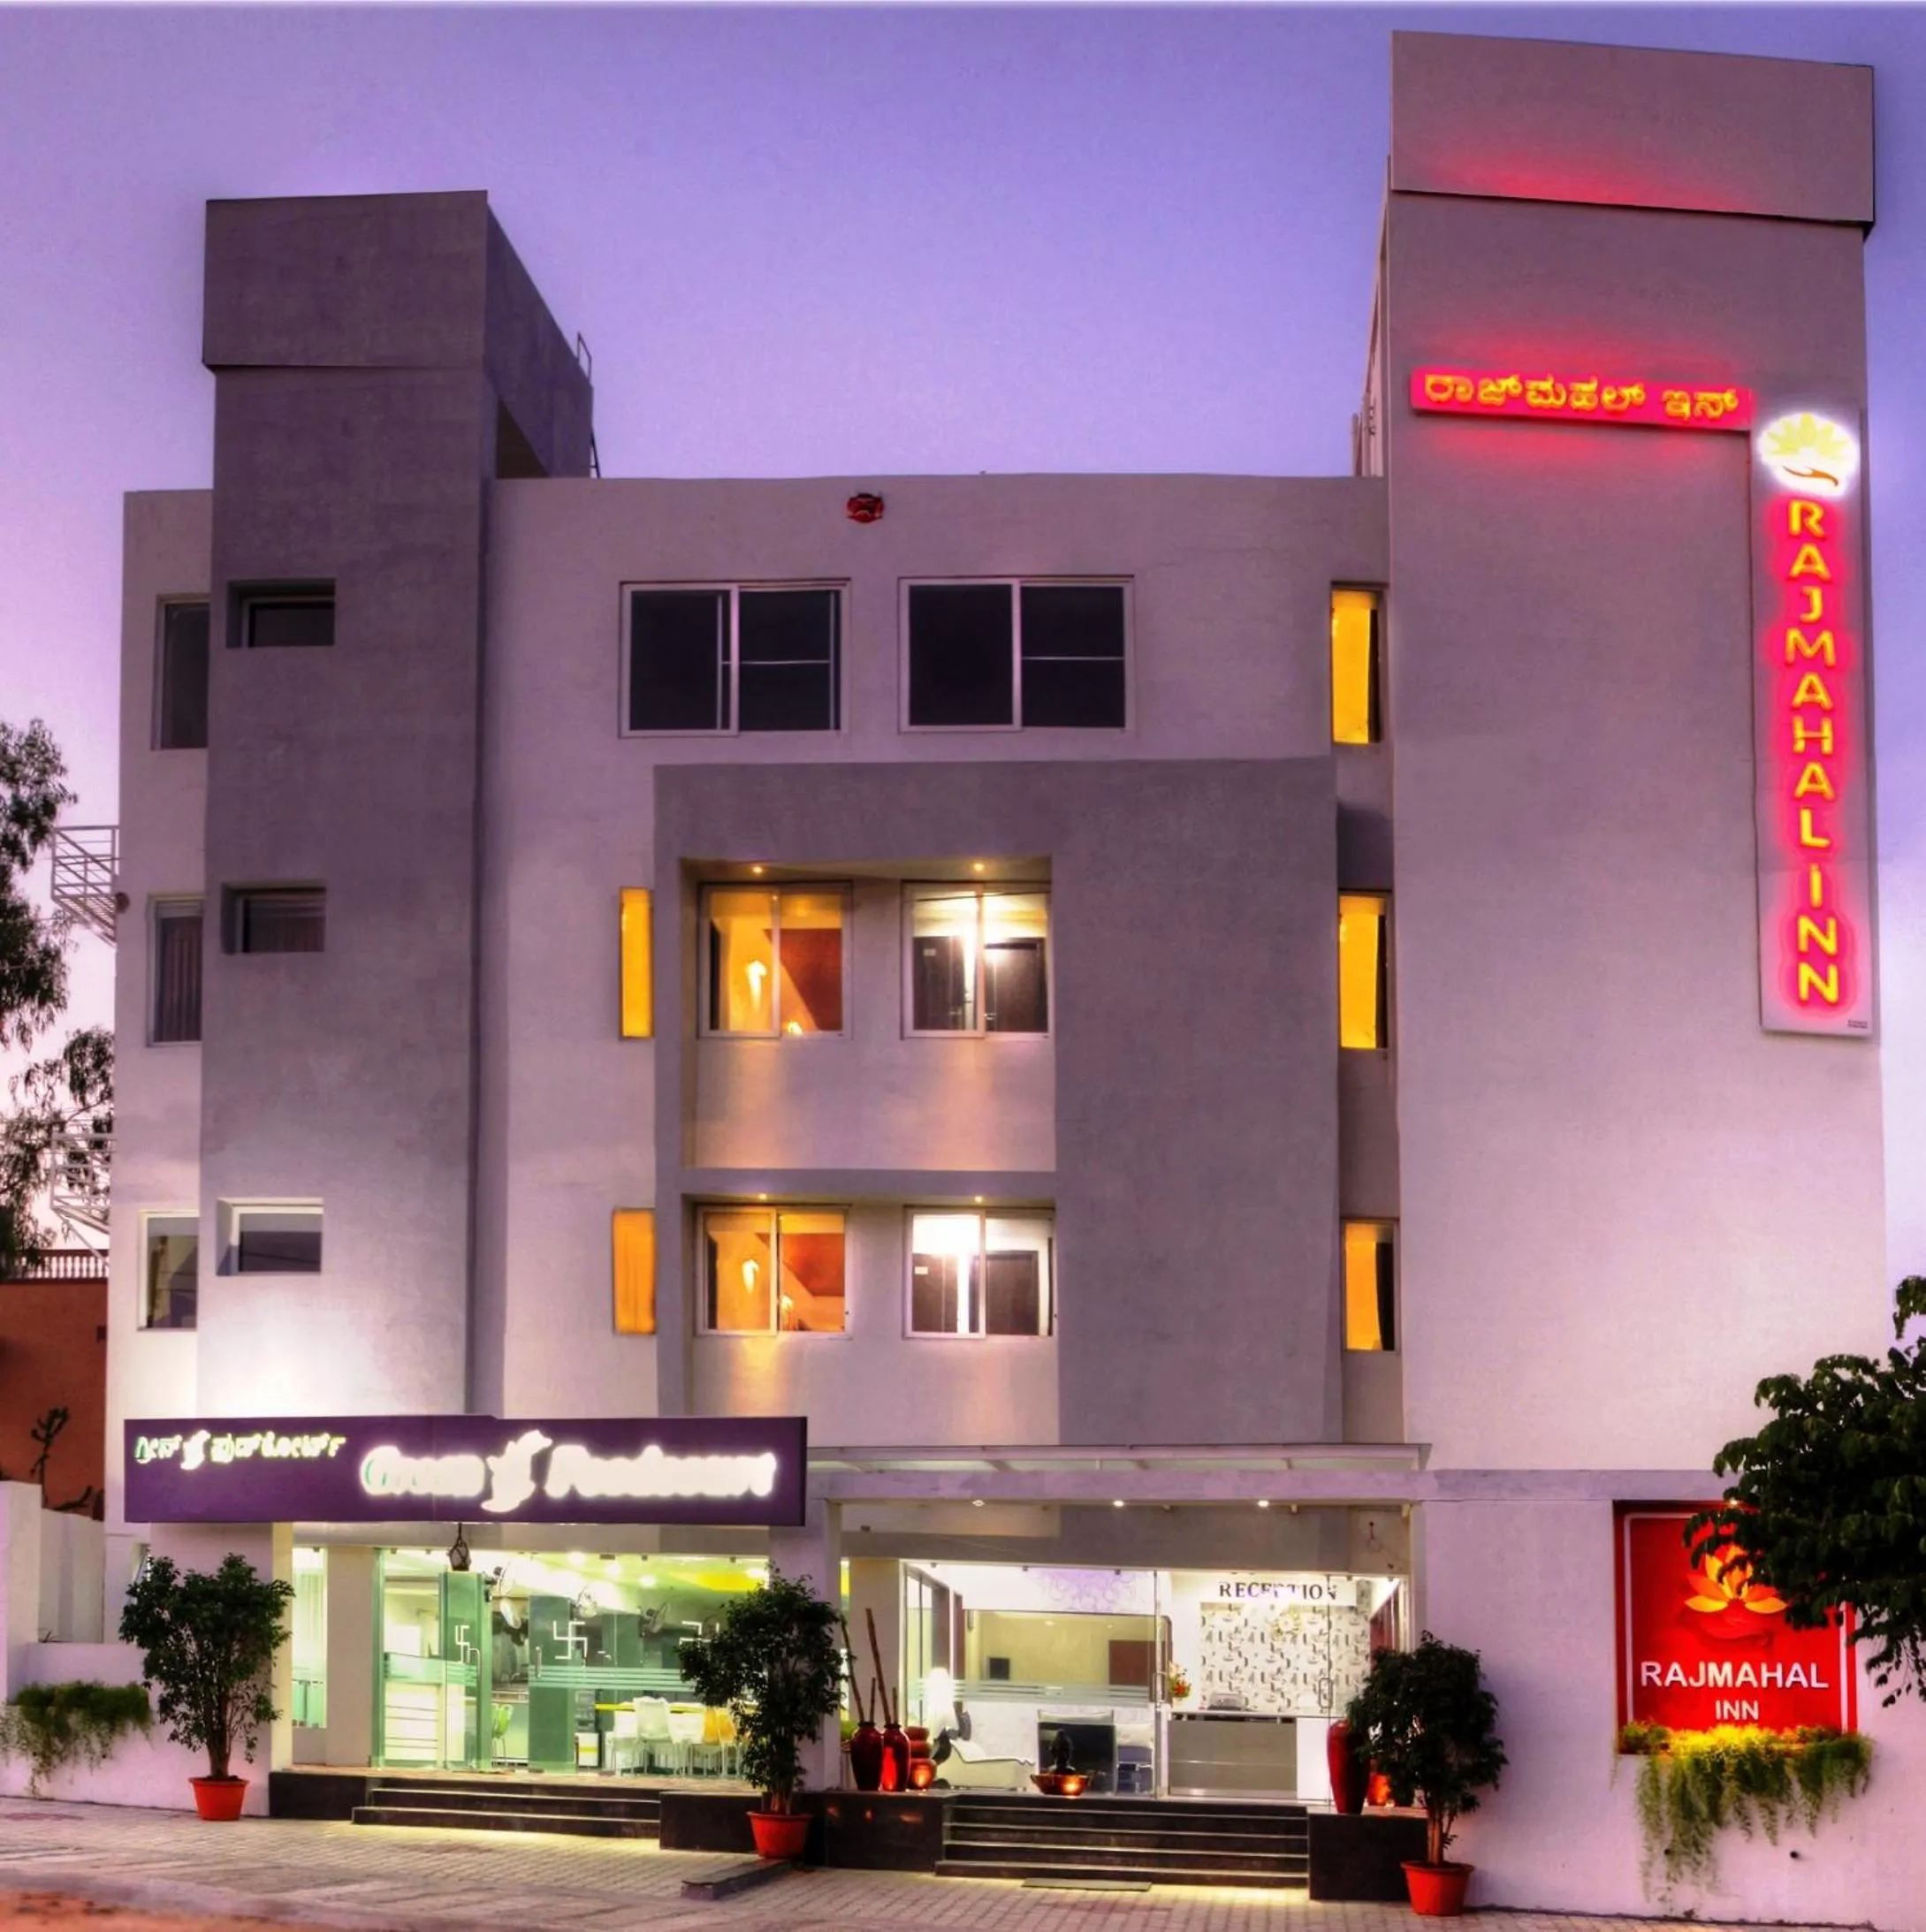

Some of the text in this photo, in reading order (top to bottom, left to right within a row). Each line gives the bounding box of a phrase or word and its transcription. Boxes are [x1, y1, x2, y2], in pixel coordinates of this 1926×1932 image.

[1785, 498, 1839, 1005] RAJMAHAL INN
[1640, 1661, 1830, 1689] RAJMAHAL
[1715, 1700, 1759, 1721] INN
